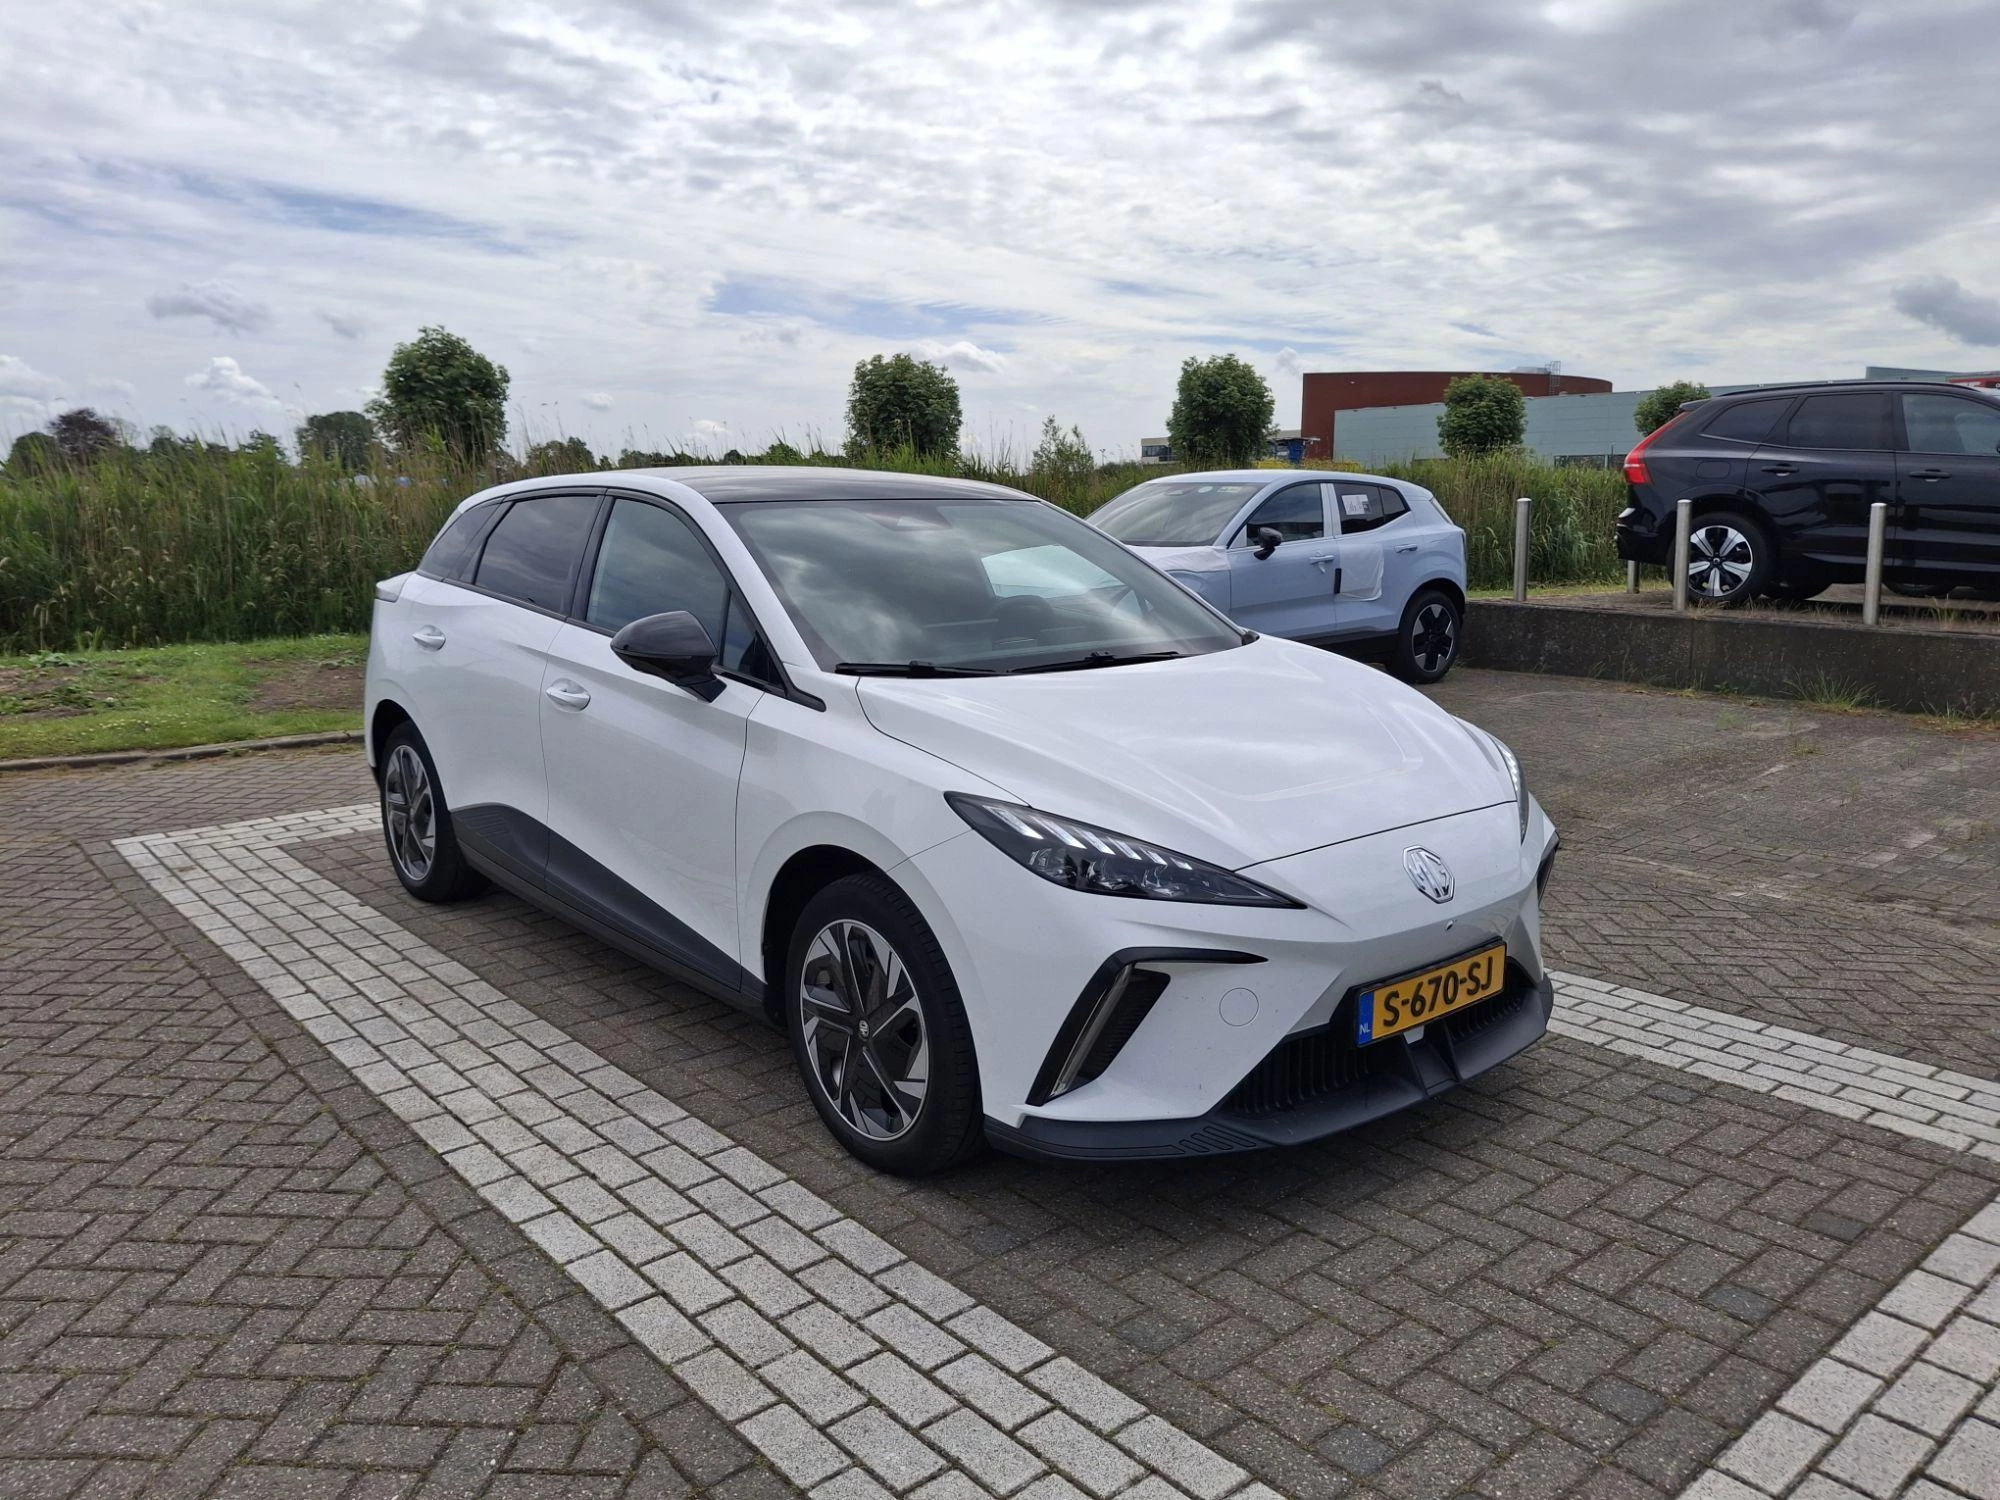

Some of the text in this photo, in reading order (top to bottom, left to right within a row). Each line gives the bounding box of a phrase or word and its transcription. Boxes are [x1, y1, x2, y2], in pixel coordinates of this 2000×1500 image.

[1407, 849, 1451, 899] MG
[1383, 956, 1493, 1027] S-670-SJ
[1359, 1022, 1370, 1035] NL
